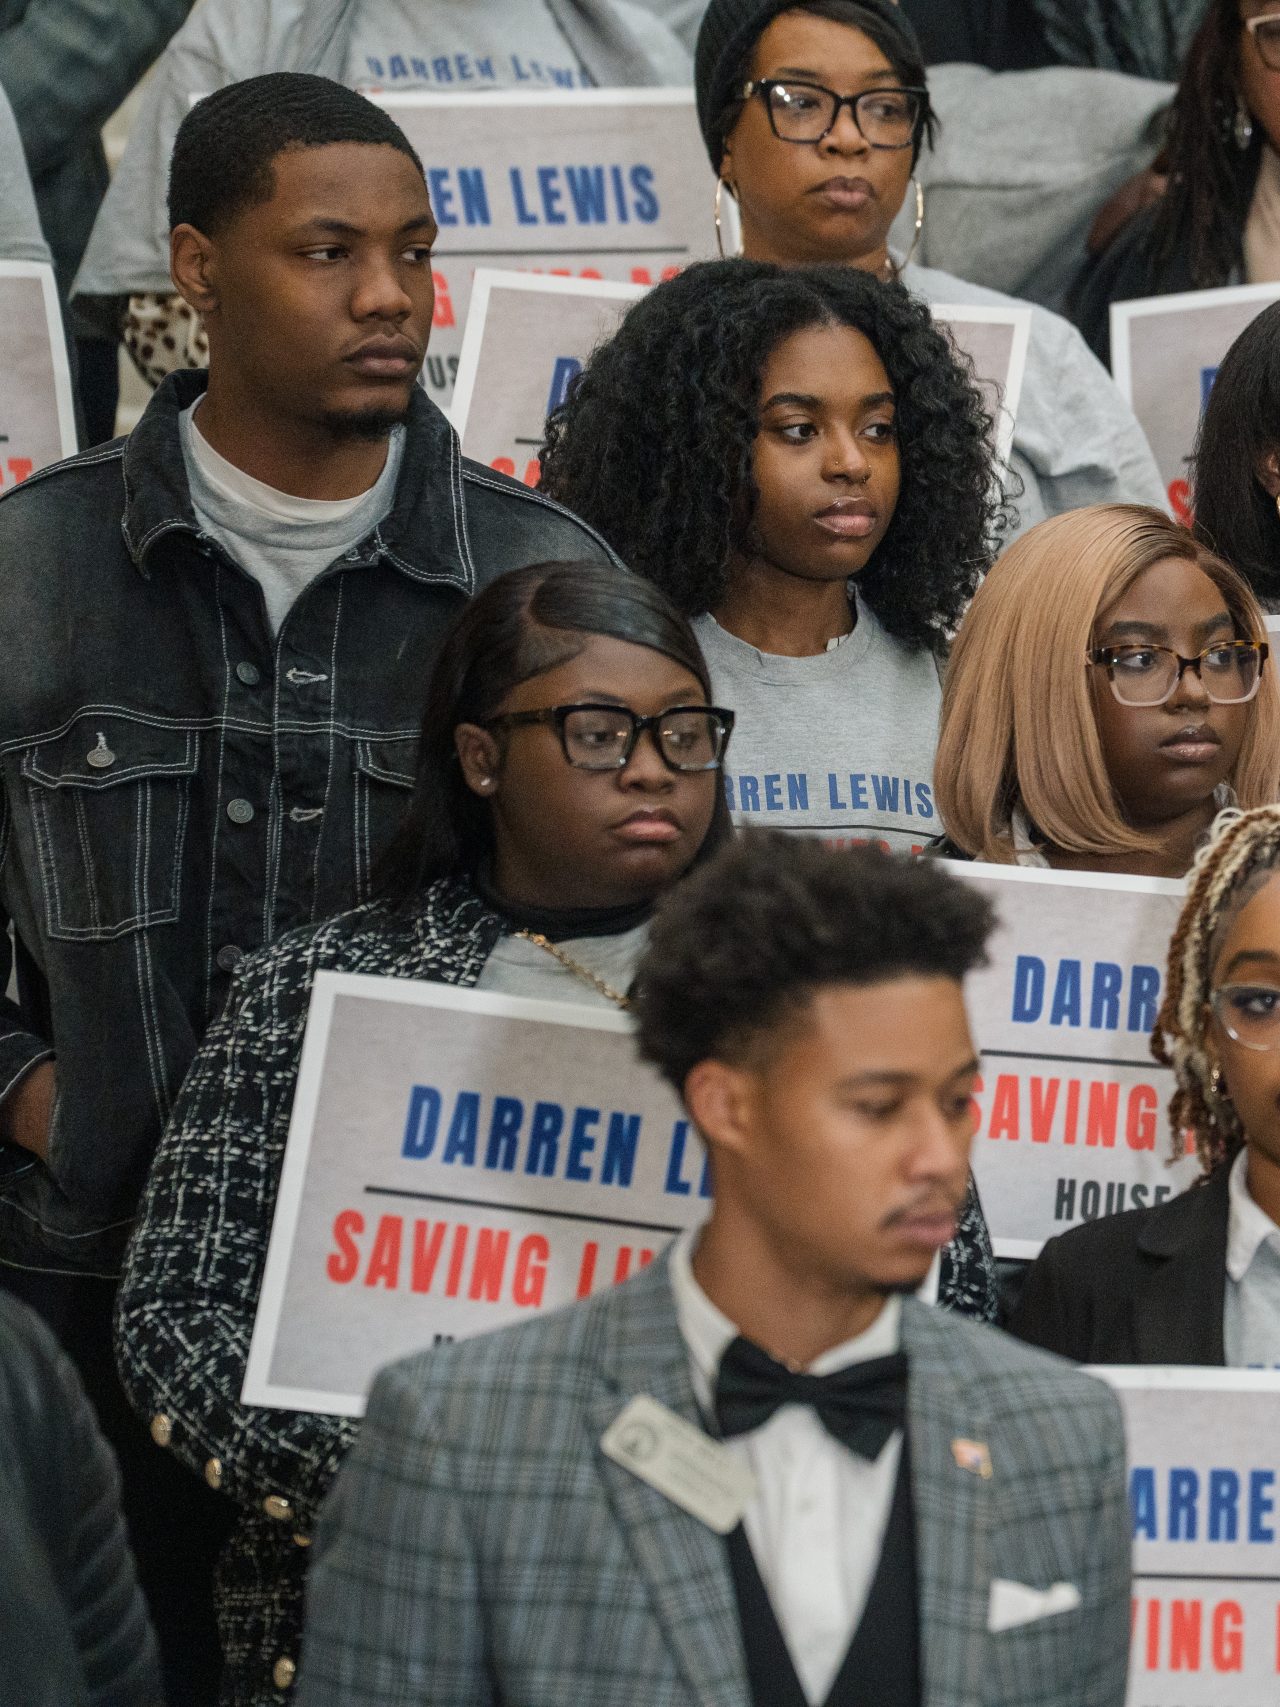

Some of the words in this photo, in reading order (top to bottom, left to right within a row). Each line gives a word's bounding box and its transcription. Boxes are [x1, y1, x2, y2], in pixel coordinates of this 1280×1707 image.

[509, 163, 660, 226] LEWIS
[724, 773, 809, 811] RREN
[828, 773, 934, 819] LEWIS
[1012, 955, 1161, 1034] DARR
[401, 1083, 641, 1188] DARREN
[326, 1208, 550, 1308] SAVING
[1132, 1598, 1244, 1674] ING
